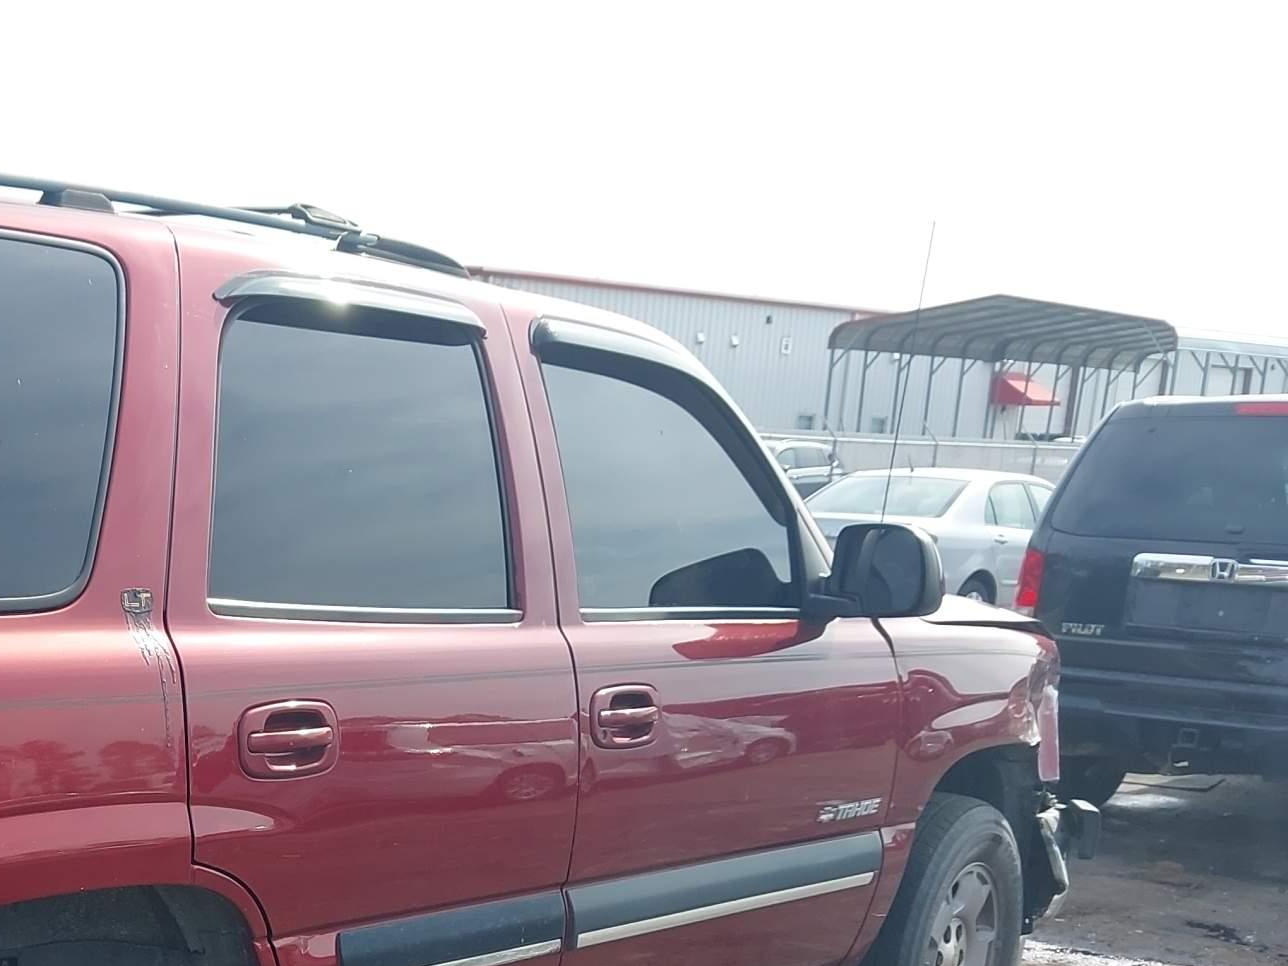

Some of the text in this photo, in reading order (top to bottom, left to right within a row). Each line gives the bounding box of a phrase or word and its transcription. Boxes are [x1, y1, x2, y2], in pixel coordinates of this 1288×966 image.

[123, 591, 152, 608] LT
[1061, 622, 1105, 636] PILOT
[835, 797, 882, 820] TAHOE
